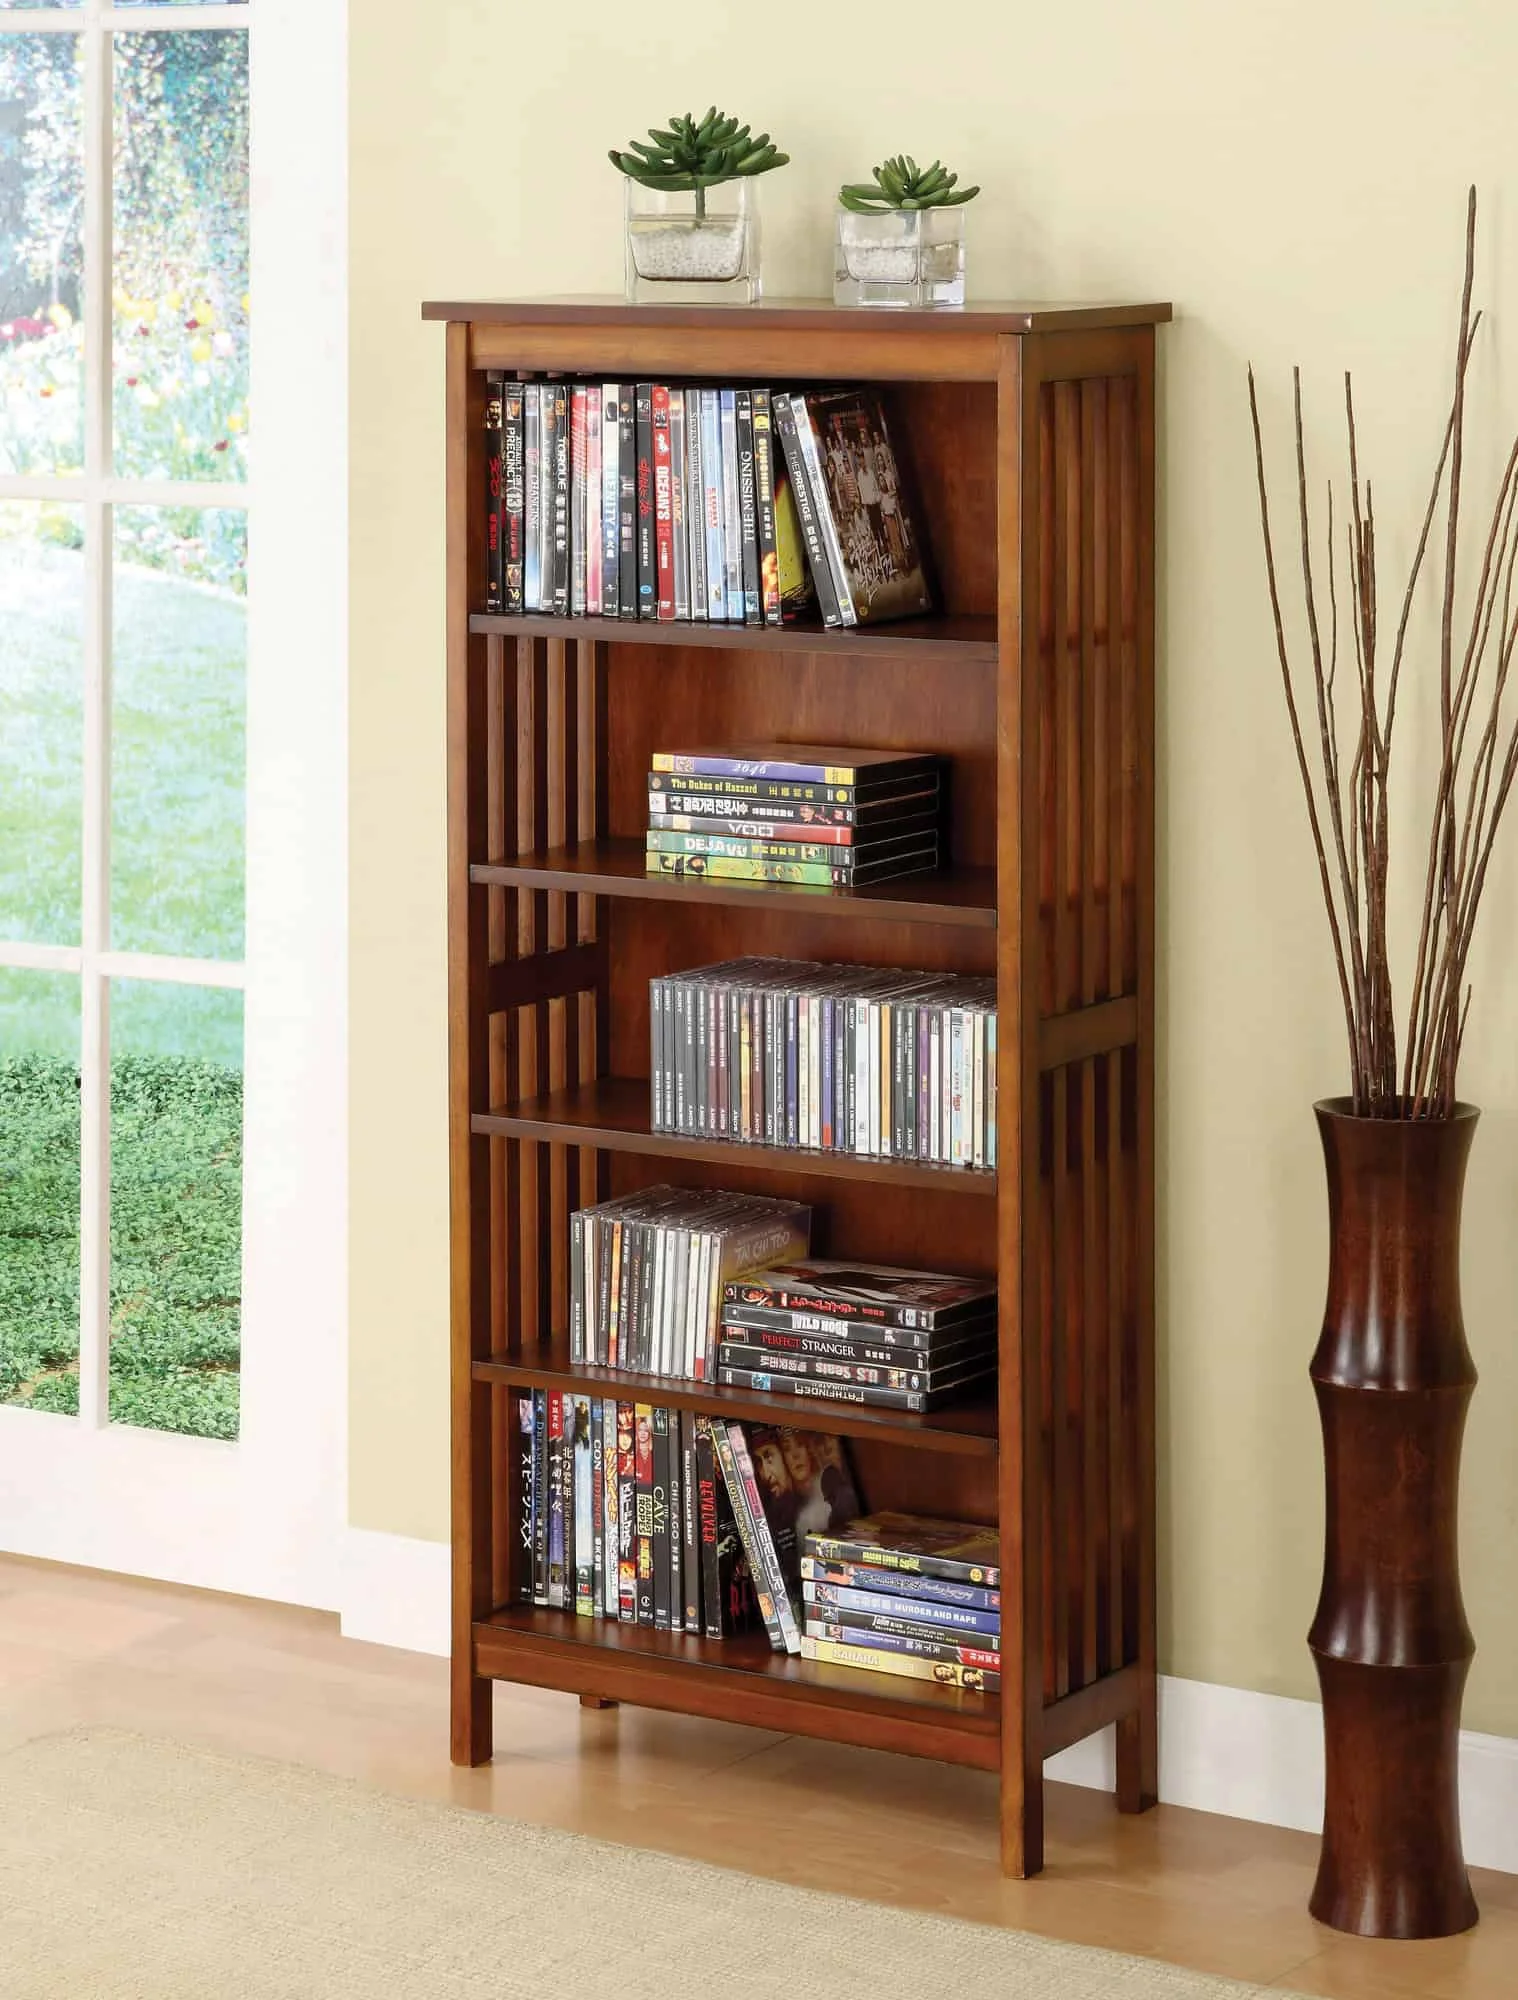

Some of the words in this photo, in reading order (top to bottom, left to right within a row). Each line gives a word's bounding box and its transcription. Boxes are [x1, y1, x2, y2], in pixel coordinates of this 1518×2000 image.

[506, 427, 516, 485] PRECINCT
[557, 436, 566, 490] TORQUE
[656, 466, 670, 521] OCEAN'S
[740, 451, 754, 511] MISSING
[743, 513, 756, 543] THE
[672, 778, 687, 789] The
[688, 780, 713, 791] Dukes
[715, 782, 723, 790] of
[725, 782, 758, 794] Hazzard
[761, 1333, 801, 1349] PERFECT
[801, 1338, 857, 1357] STRANGER
[791, 1312, 820, 1330] WILD
[820, 1318, 849, 1338] HOGS
[794, 1382, 865, 1403] PATHFINDER
[639, 1500, 647, 1534] ROPES
[644, 1496, 652, 1534] AGAINST
[654, 1486, 665, 1534] CAVE
[671, 1480, 680, 1540] CHICAGO
[700, 1479, 716, 1544] REVOLVER
[755, 1517, 787, 1601] MERCURY
[894, 1601, 933, 1618] MURDER
[933, 1609, 952, 1620] AND
[952, 1612, 977, 1625] RAPE
